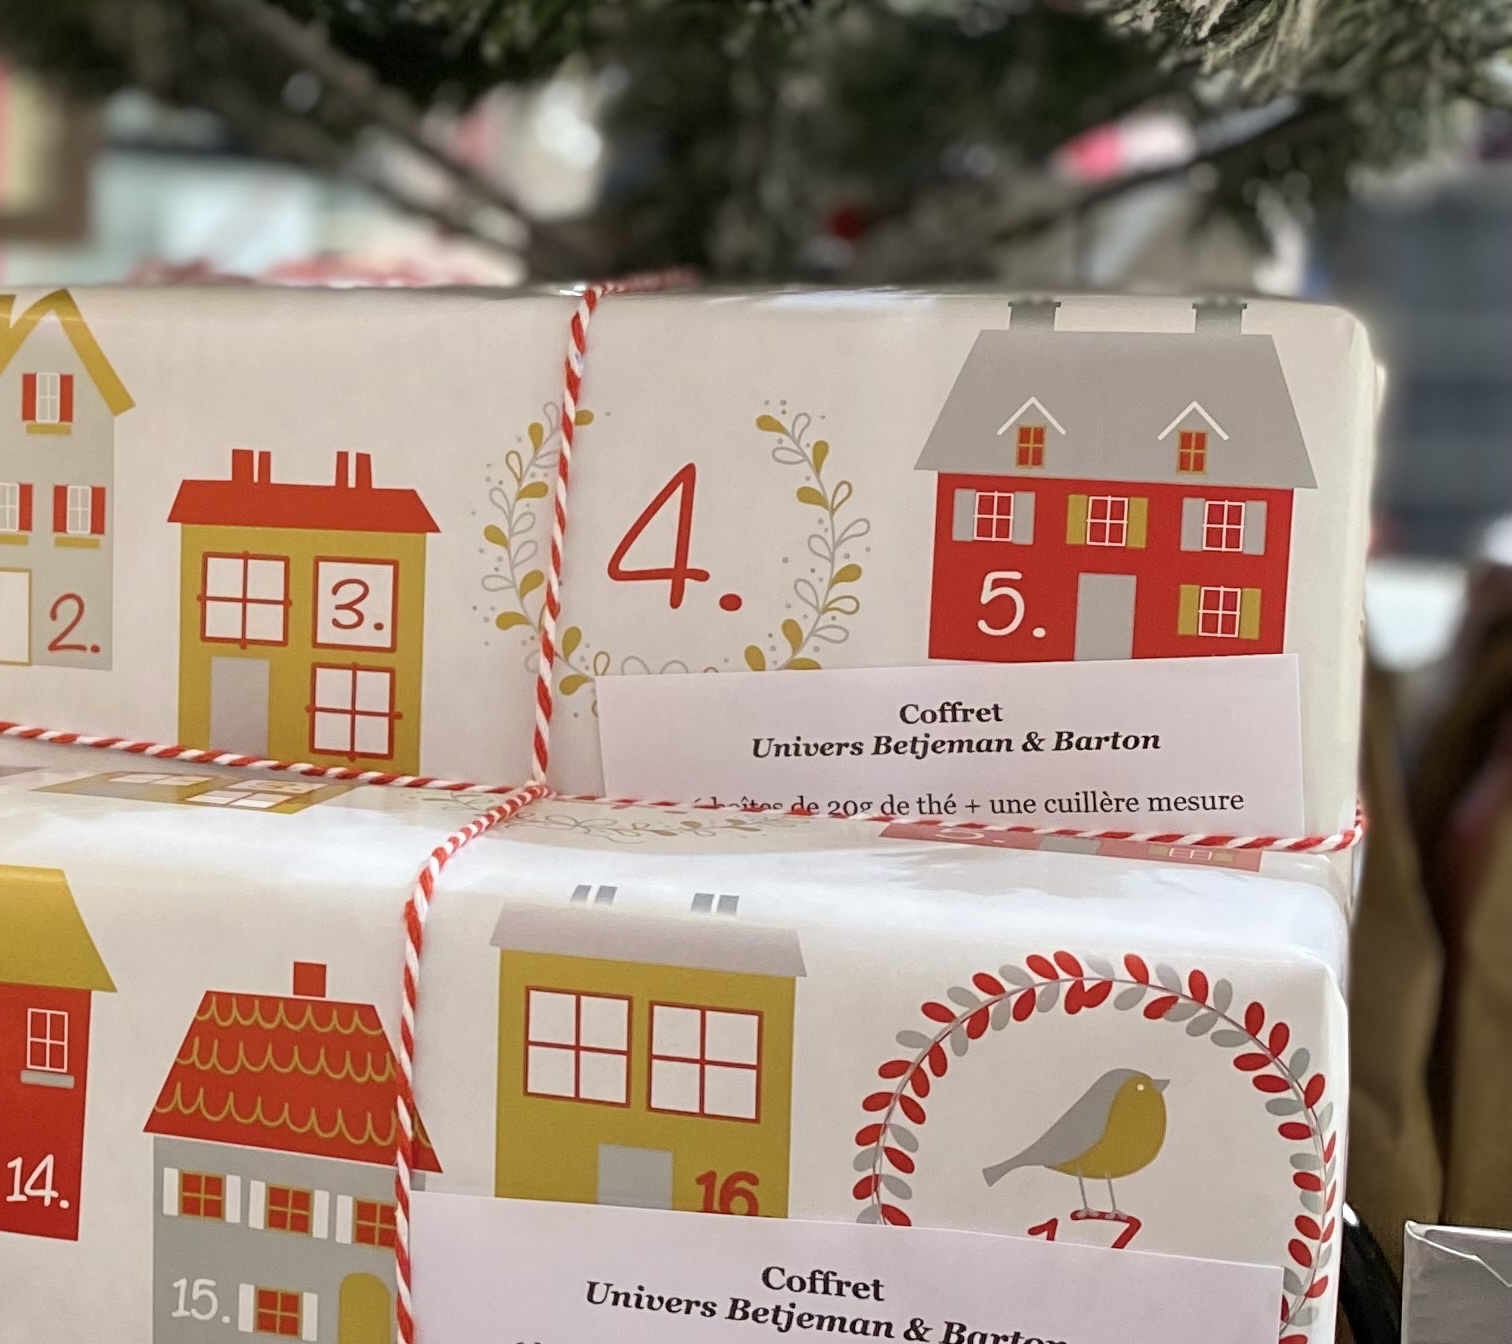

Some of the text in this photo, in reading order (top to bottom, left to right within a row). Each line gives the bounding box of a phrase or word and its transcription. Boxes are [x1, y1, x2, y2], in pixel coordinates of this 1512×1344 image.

[607, 462, 743, 612] 4.
[47, 593, 101, 653] 2.
[330, 578, 385, 631] 3.
[976, 570, 1047, 639] 5.
[899, 702, 1004, 725] Coffret
[751, 729, 1162, 760] Univers Betjeman & Barton
[791, 795, 820, 815] de
[880, 794, 910, 816] de
[916, 793, 957, 816] thé
[965, 799, 981, 814] +
[990, 797, 1036, 814] une
[1044, 791, 1139, 813] cuillère
[1147, 794, 1244, 812] mesure
[5, 1154, 70, 1209] 14.
[170, 1278, 231, 1324] 15.
[762, 1265, 884, 1302] Coffret
[586, 1281, 717, 1319] Univers
[725, 1297, 895, 1339] Betjeman
[903, 1317, 931, 1342] &
